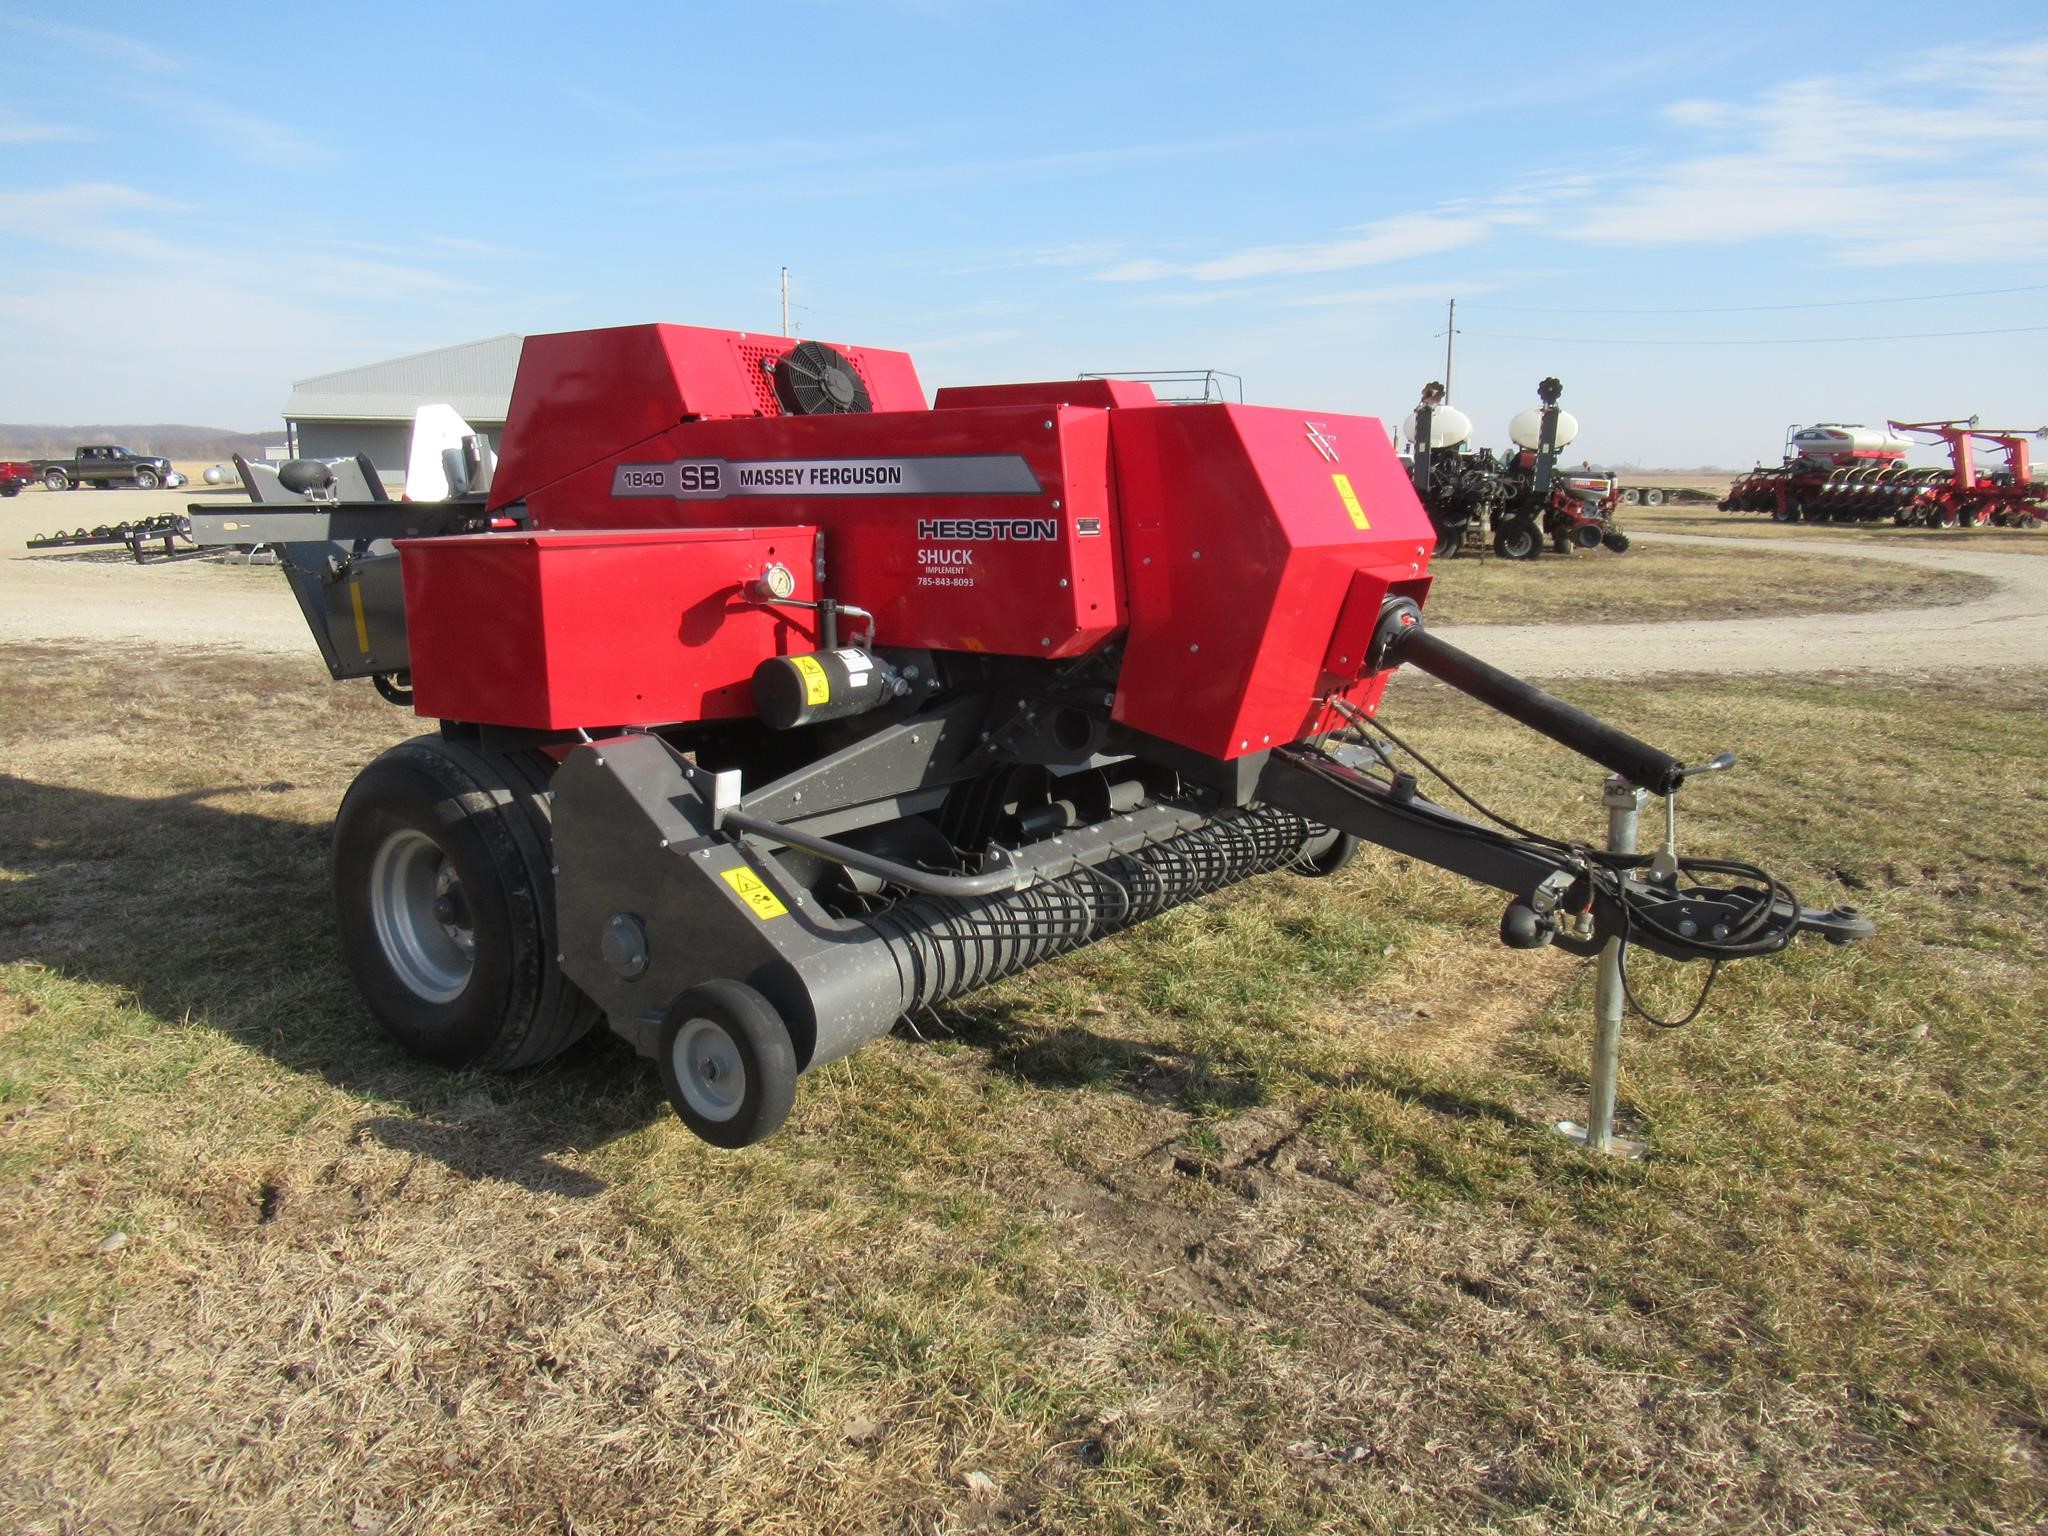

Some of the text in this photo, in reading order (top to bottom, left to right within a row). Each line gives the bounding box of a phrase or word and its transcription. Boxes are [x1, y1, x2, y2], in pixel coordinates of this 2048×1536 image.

[624, 471, 664, 487] 1840
[680, 464, 721, 491] SB
[740, 466, 902, 486] MASSEY FERGUSON
[918, 518, 1057, 541] HESSTON
[917, 549, 972, 565] SHUCK
[925, 566, 965, 575] IMPLEMENT
[917, 577, 974, 587] 785-843-8093
